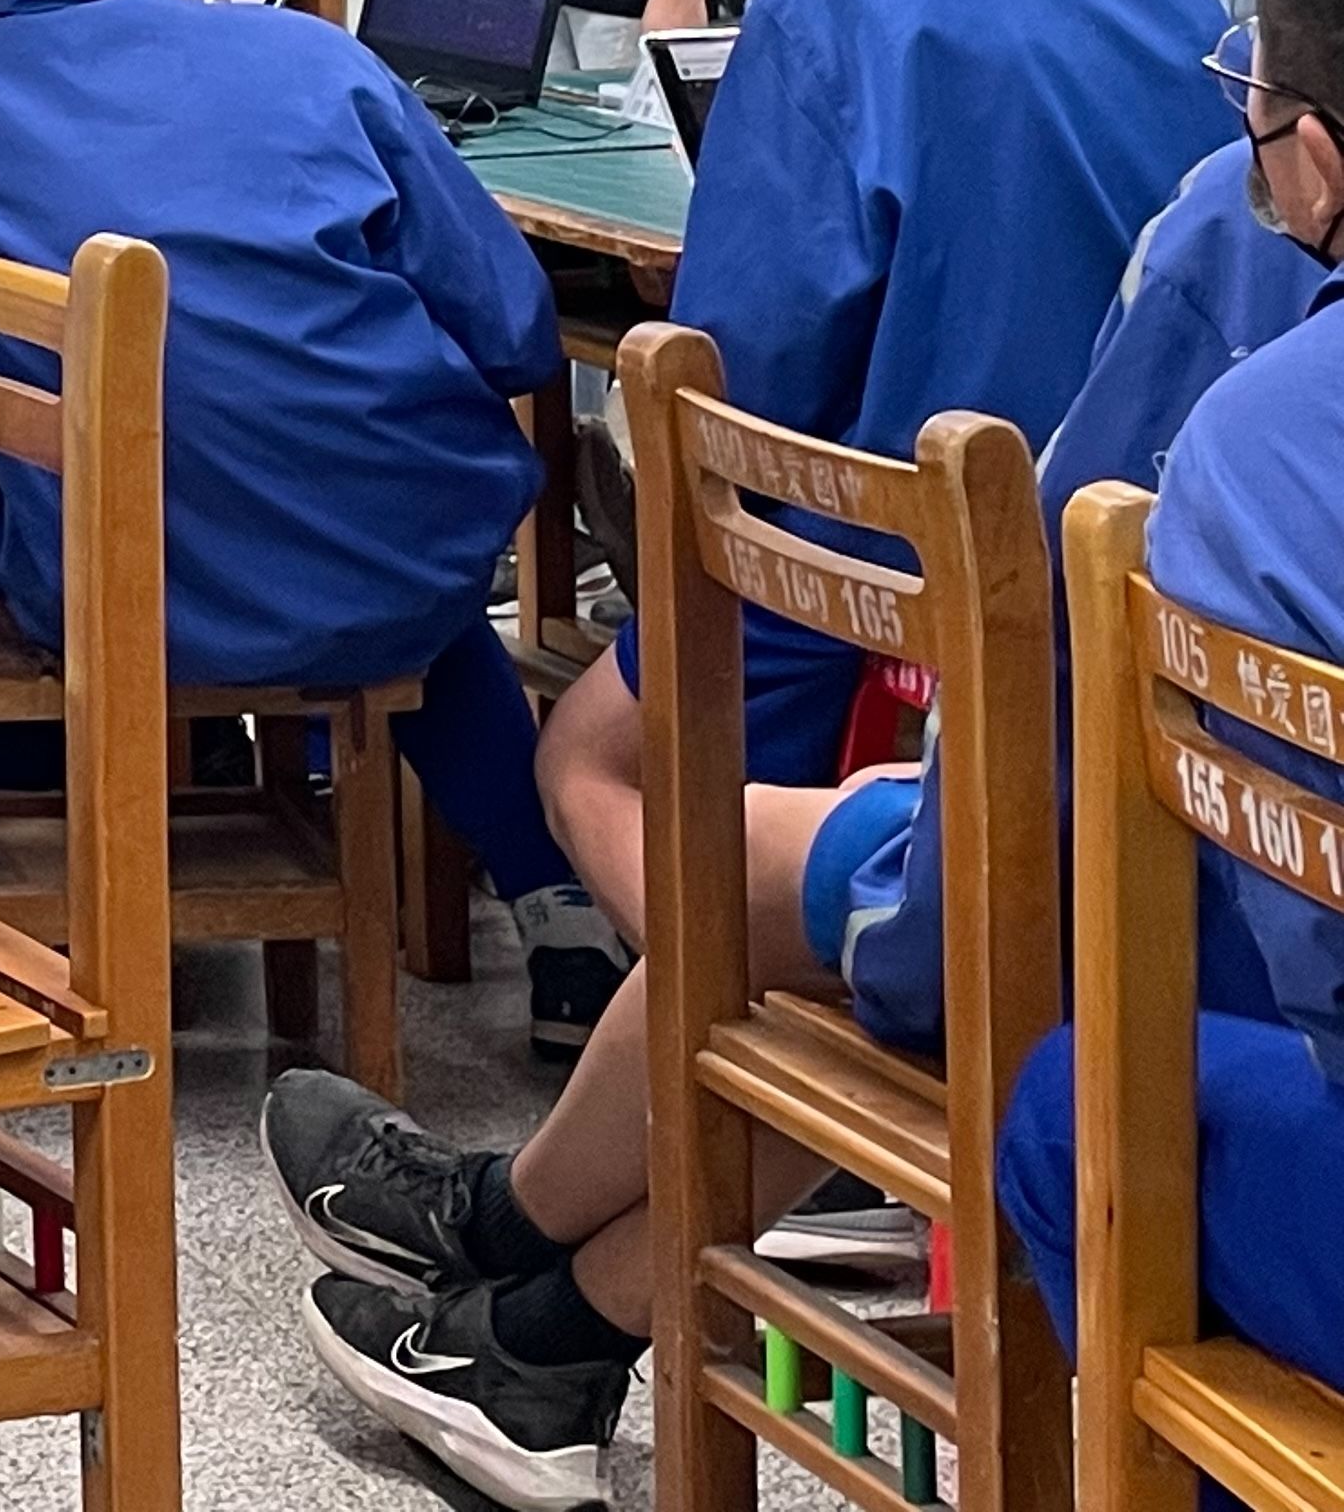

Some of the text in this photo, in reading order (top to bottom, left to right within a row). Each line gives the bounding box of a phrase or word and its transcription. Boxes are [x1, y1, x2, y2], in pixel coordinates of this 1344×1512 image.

[723, 533, 767, 598] 155
[841, 576, 904, 649] 165
[1158, 607, 1209, 688] 105
[1176, 749, 1230, 838] 155
[1240, 785, 1304, 877] 160
